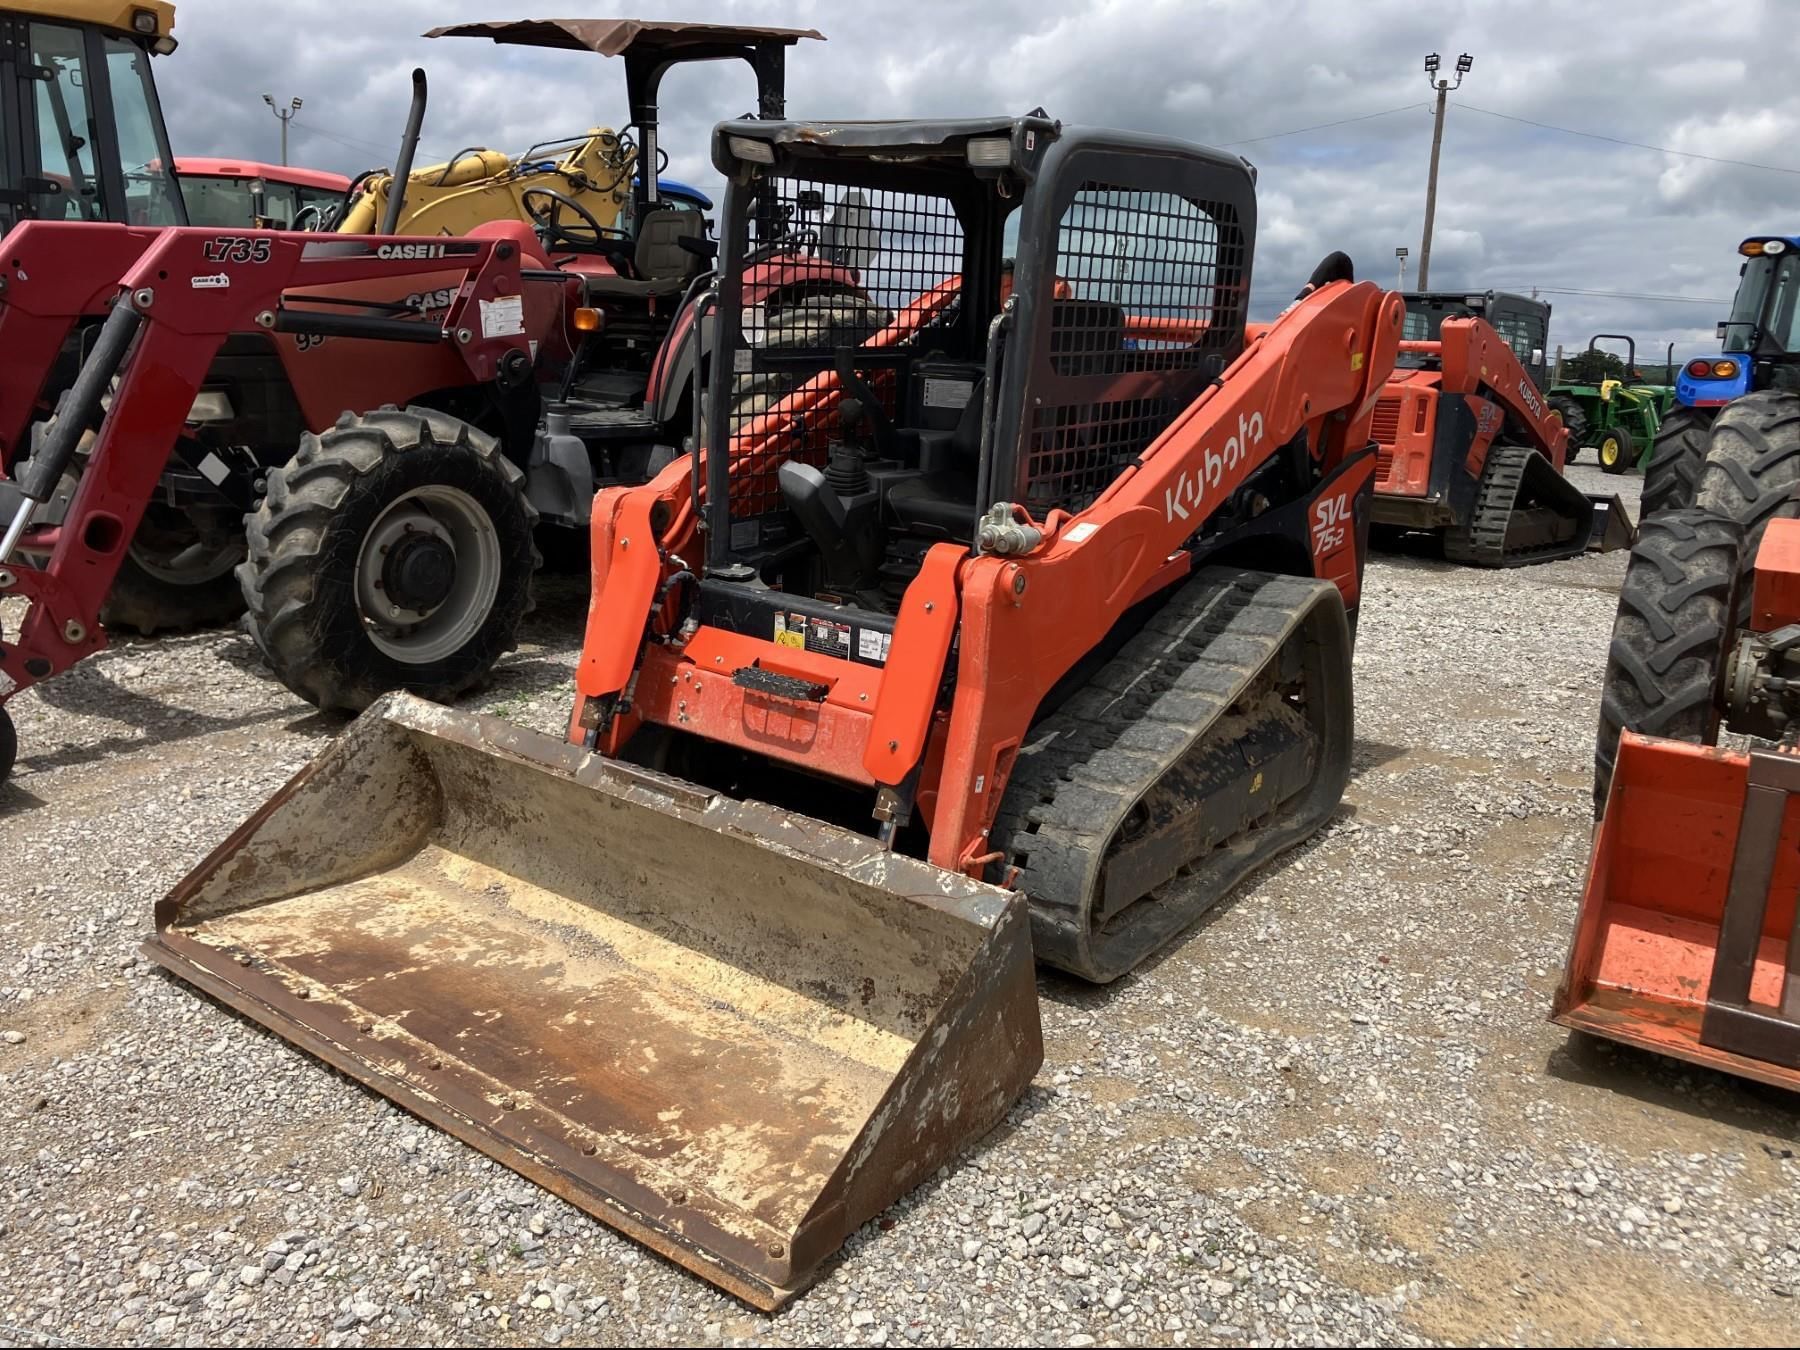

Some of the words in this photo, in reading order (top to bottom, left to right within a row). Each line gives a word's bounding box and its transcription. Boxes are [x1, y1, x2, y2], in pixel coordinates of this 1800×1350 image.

[203, 237, 271, 263] L735
[1518, 378, 1541, 420] KUBOTA
[1165, 411, 1263, 523] Kubota
[1312, 493, 1351, 532] SVL
[1314, 526, 1345, 556] 75-2
